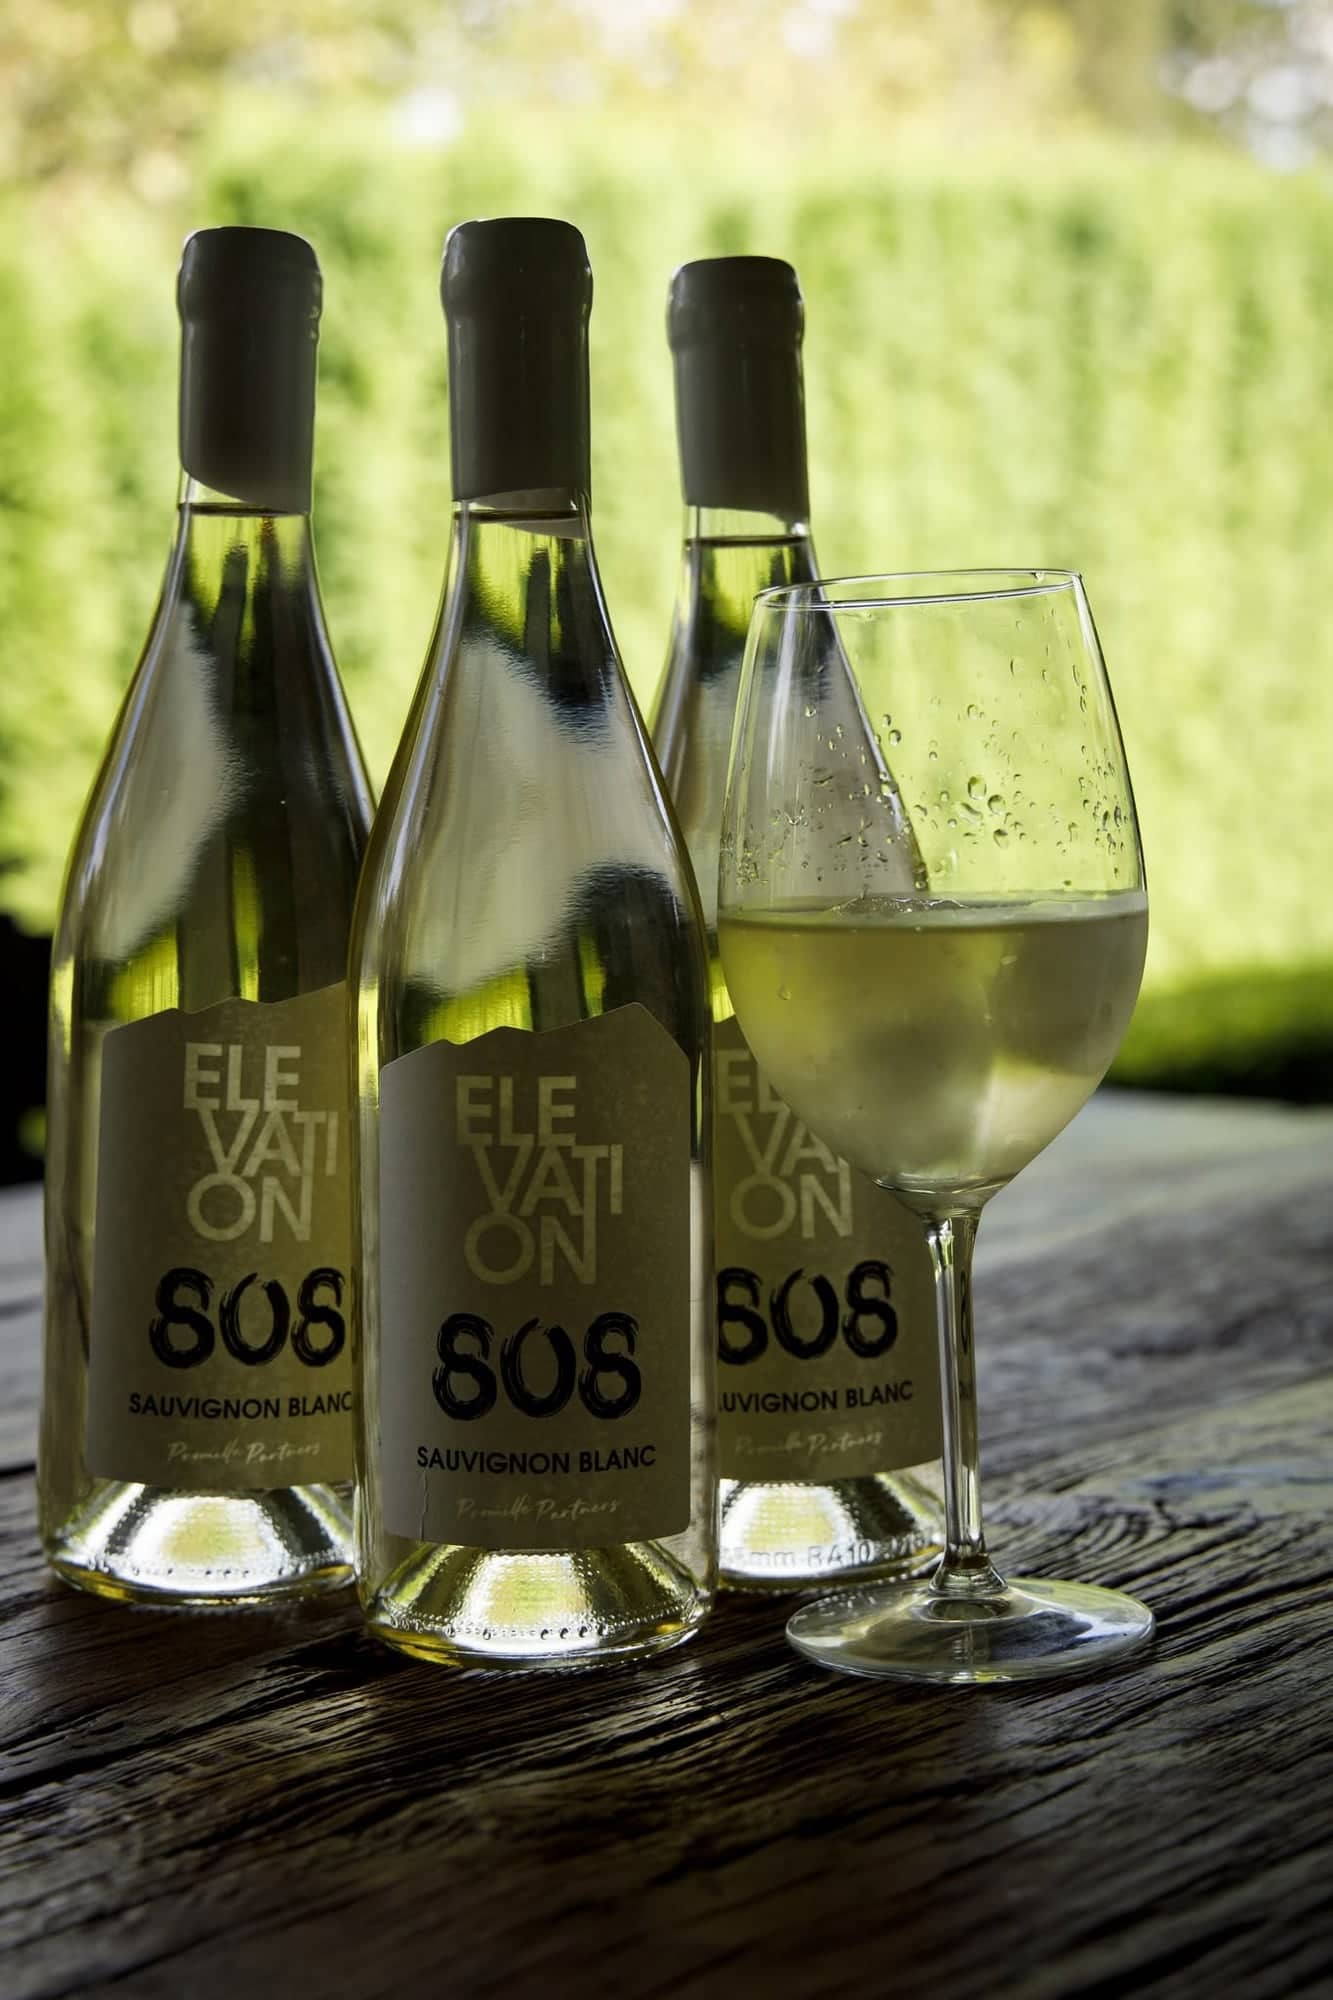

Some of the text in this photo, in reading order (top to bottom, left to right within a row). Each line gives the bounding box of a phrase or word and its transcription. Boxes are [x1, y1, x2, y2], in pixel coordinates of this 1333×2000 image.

[184, 1042, 301, 1111] ELE
[716, 1049, 792, 1113] EL
[197, 1104, 338, 1177] VATI
[456, 1075, 577, 1146] ELE
[735, 1110, 850, 1176] VA
[187, 1172, 312, 1242] ON
[471, 1143, 624, 1217] VATI
[730, 1174, 853, 1240] ON
[464, 1213, 597, 1286] ON
[129, 1390, 352, 1419] SAUVIGNON BLANC
[719, 1380, 913, 1414] UVIGNON BLANC
[417, 1445, 656, 1475] SAUVIGNON BLANC
[536, 1497, 622, 1524] Partners
